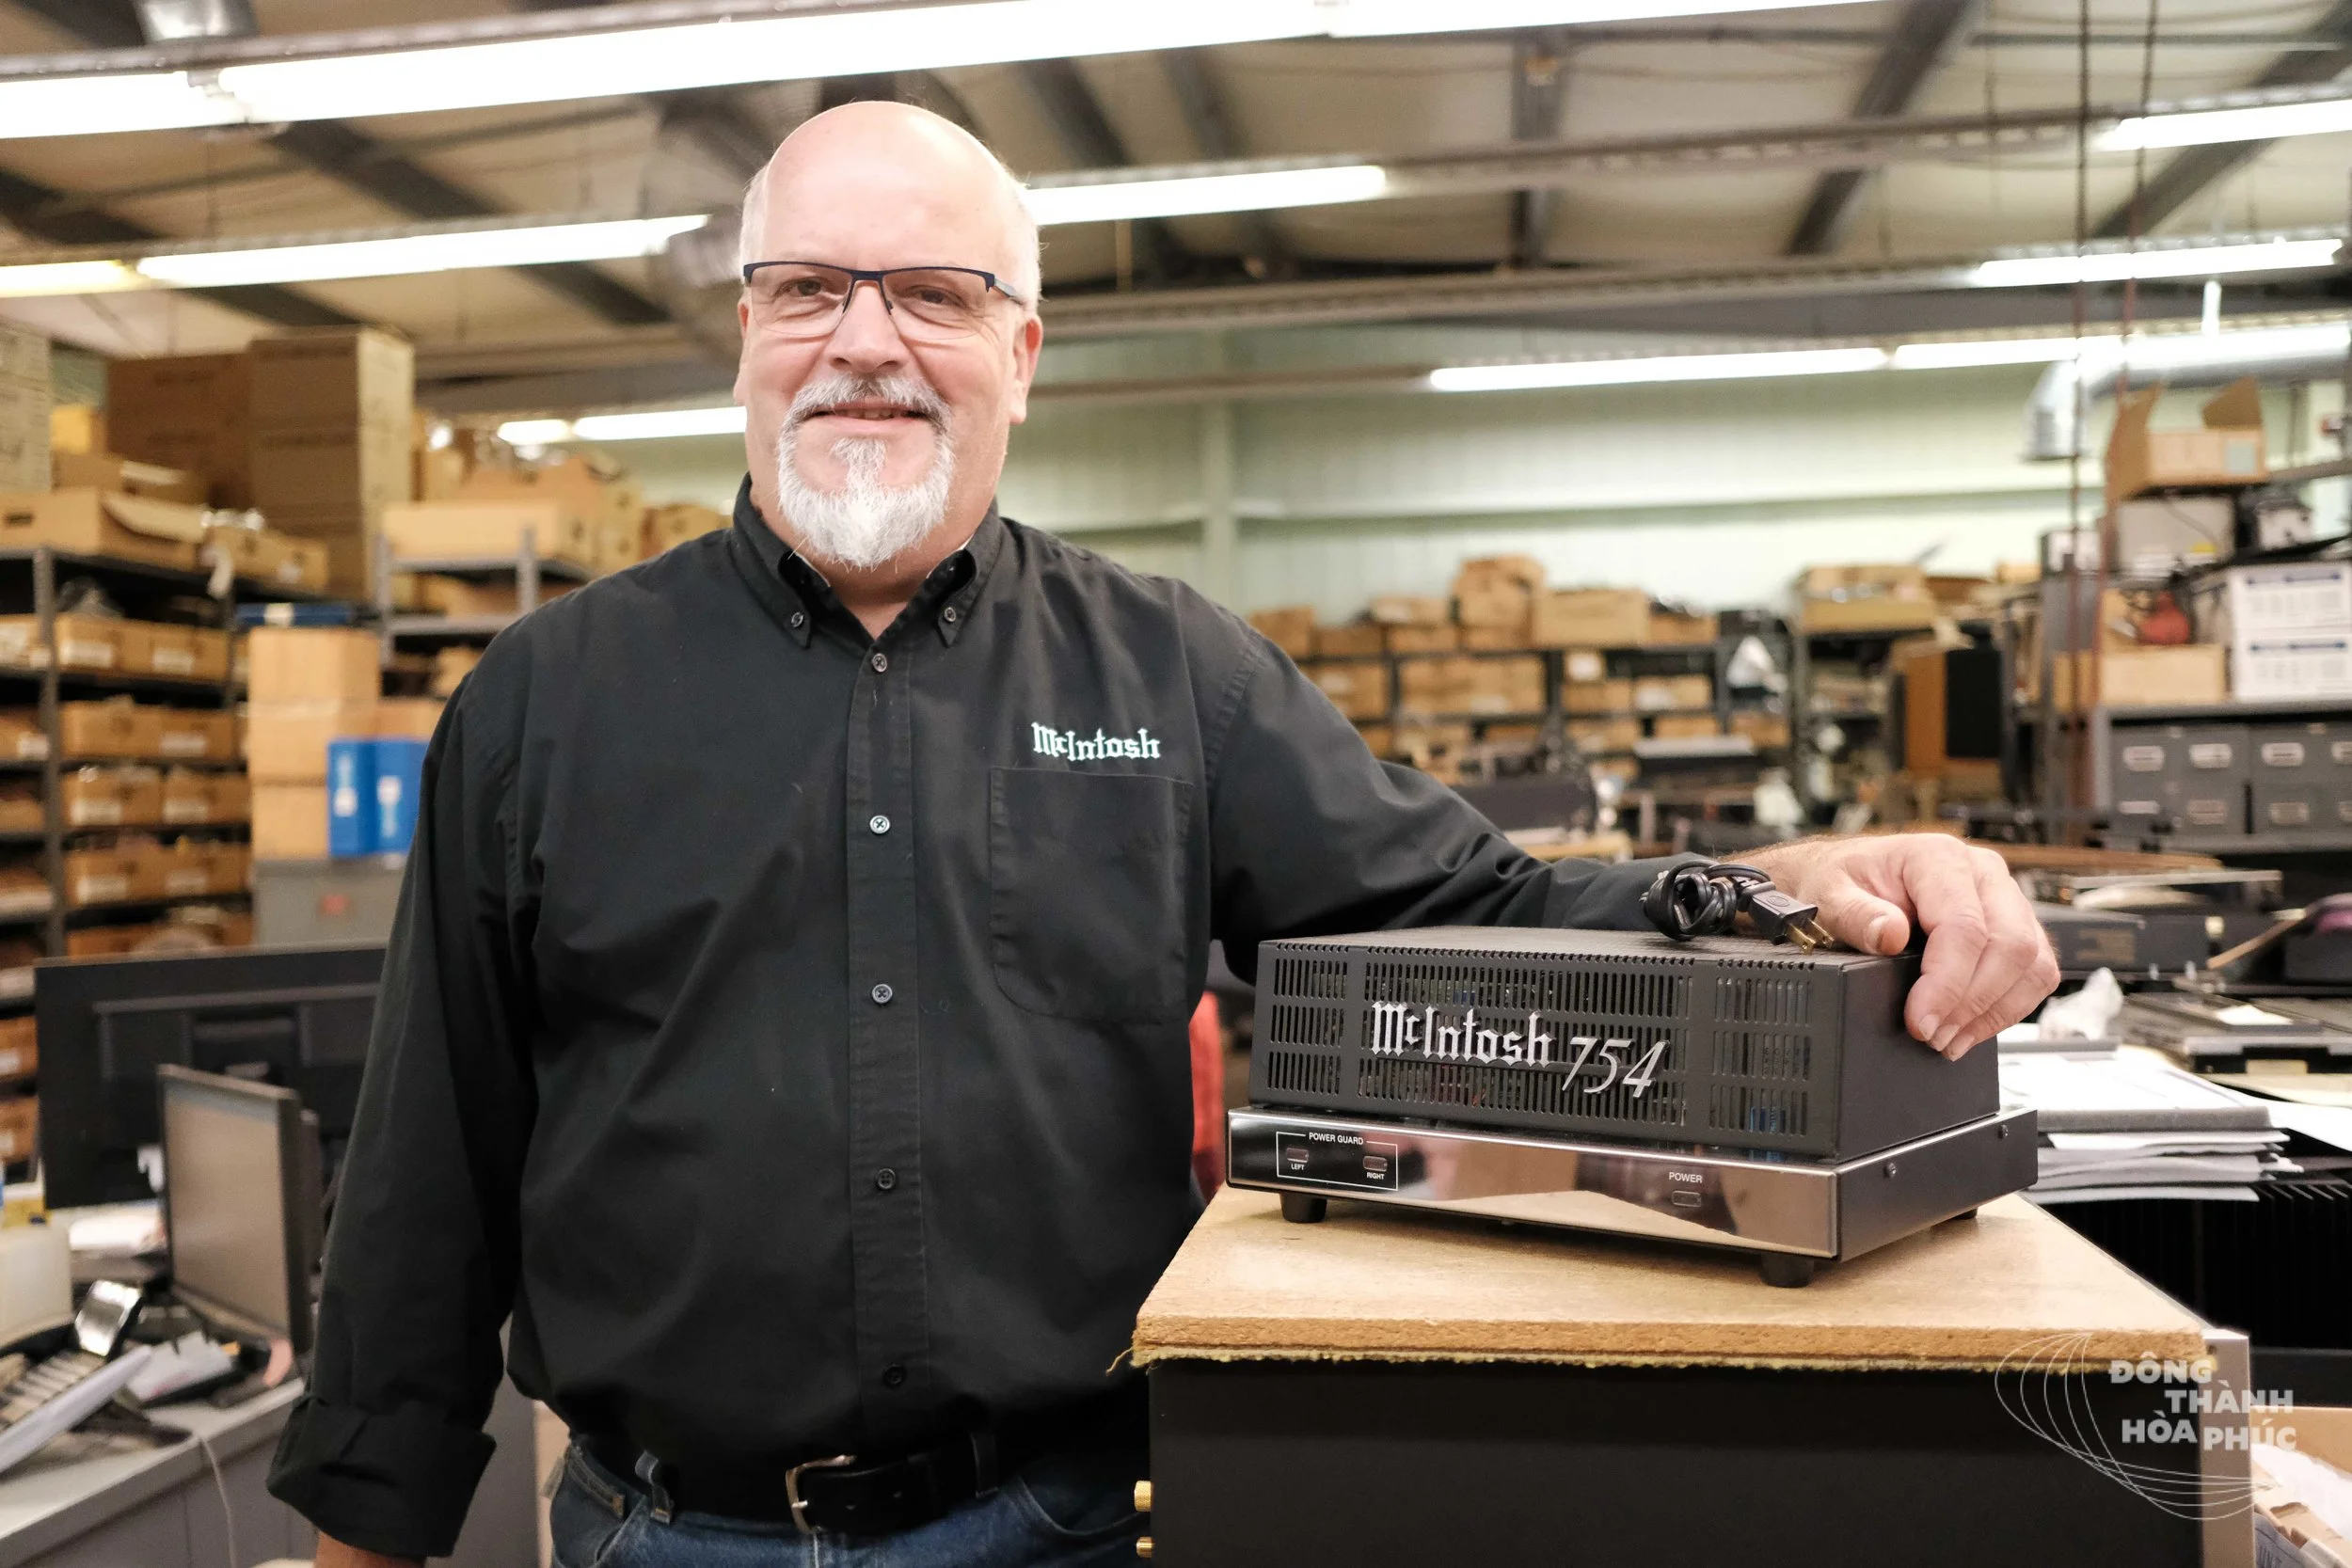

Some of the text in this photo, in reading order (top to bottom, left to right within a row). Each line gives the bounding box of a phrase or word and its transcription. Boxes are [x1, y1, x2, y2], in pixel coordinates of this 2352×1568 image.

[1031, 721, 1161, 761] McIntosh
[1372, 1001, 1670, 1098] McIntosh 754
[1309, 1132, 1363, 1145] POWER GUARD
[1668, 1171, 1703, 1183] POWER
